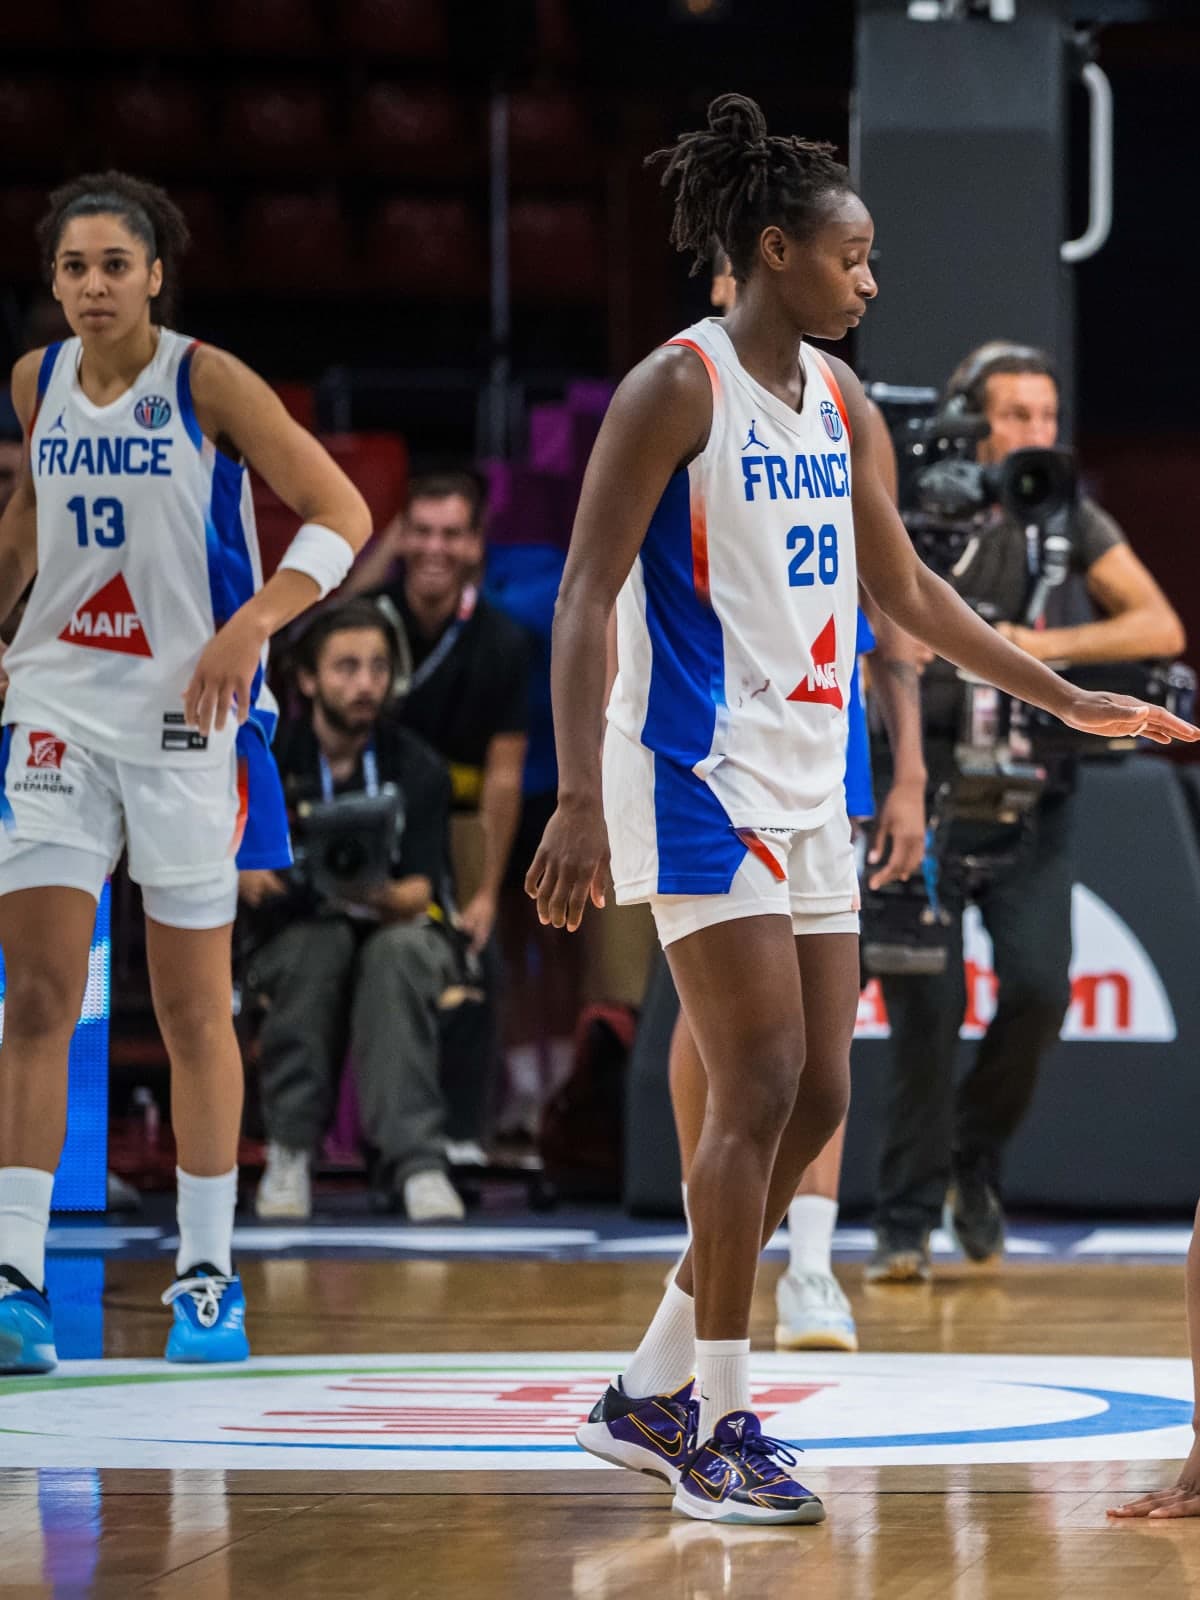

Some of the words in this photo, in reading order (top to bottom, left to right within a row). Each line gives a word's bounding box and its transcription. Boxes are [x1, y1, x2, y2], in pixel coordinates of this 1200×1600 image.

[38, 436, 173, 476] FRANCE
[741, 453, 850, 501] FRANC
[66, 496, 125, 548] 13
[786, 524, 838, 587] 28
[69, 612, 140, 638] MAIF
